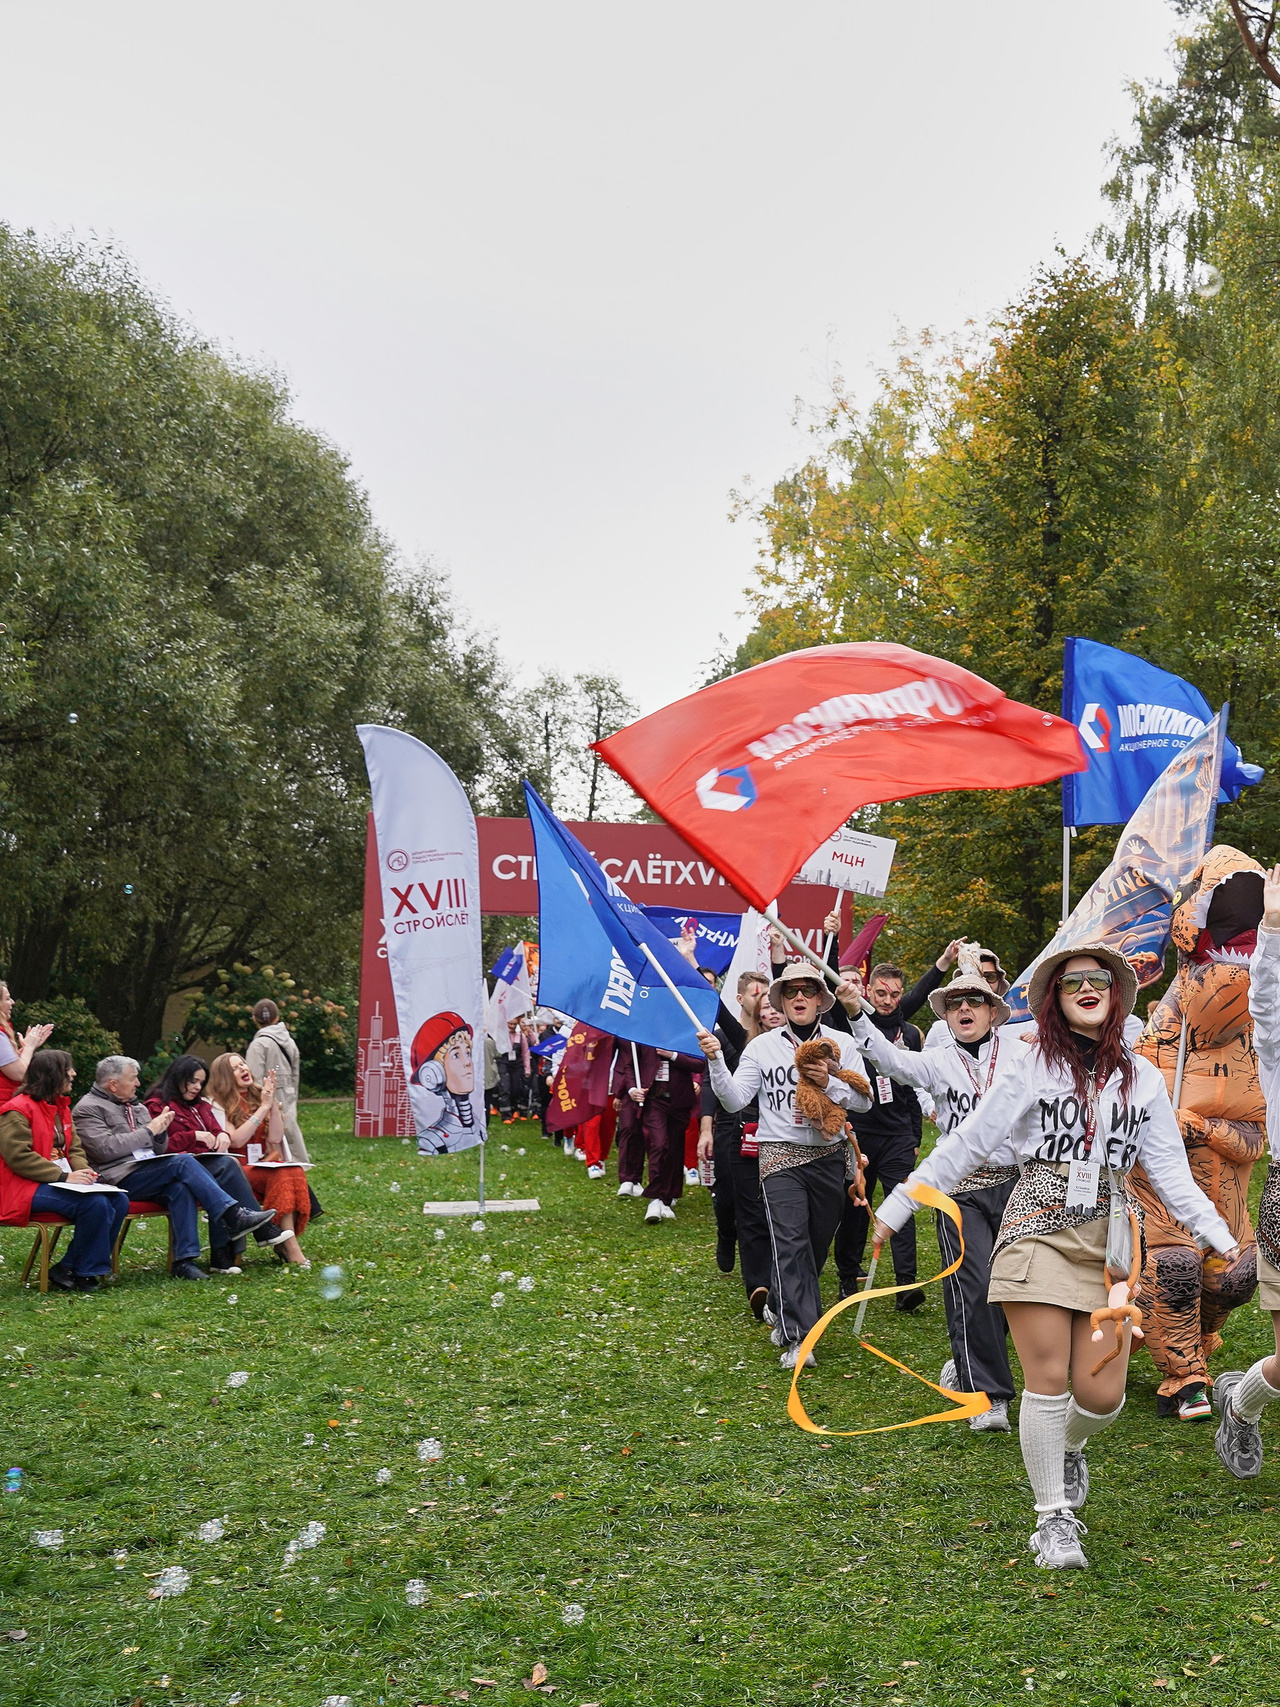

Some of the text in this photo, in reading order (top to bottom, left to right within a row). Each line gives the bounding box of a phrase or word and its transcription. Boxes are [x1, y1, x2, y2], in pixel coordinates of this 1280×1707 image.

[1118, 738, 1170, 753] АКЦИОНЕРНОЕ
[831, 850, 866, 868] МЦН
[389, 878, 468, 918] XVIII
[393, 911, 469, 935] СТРОЙСЛЁТ
